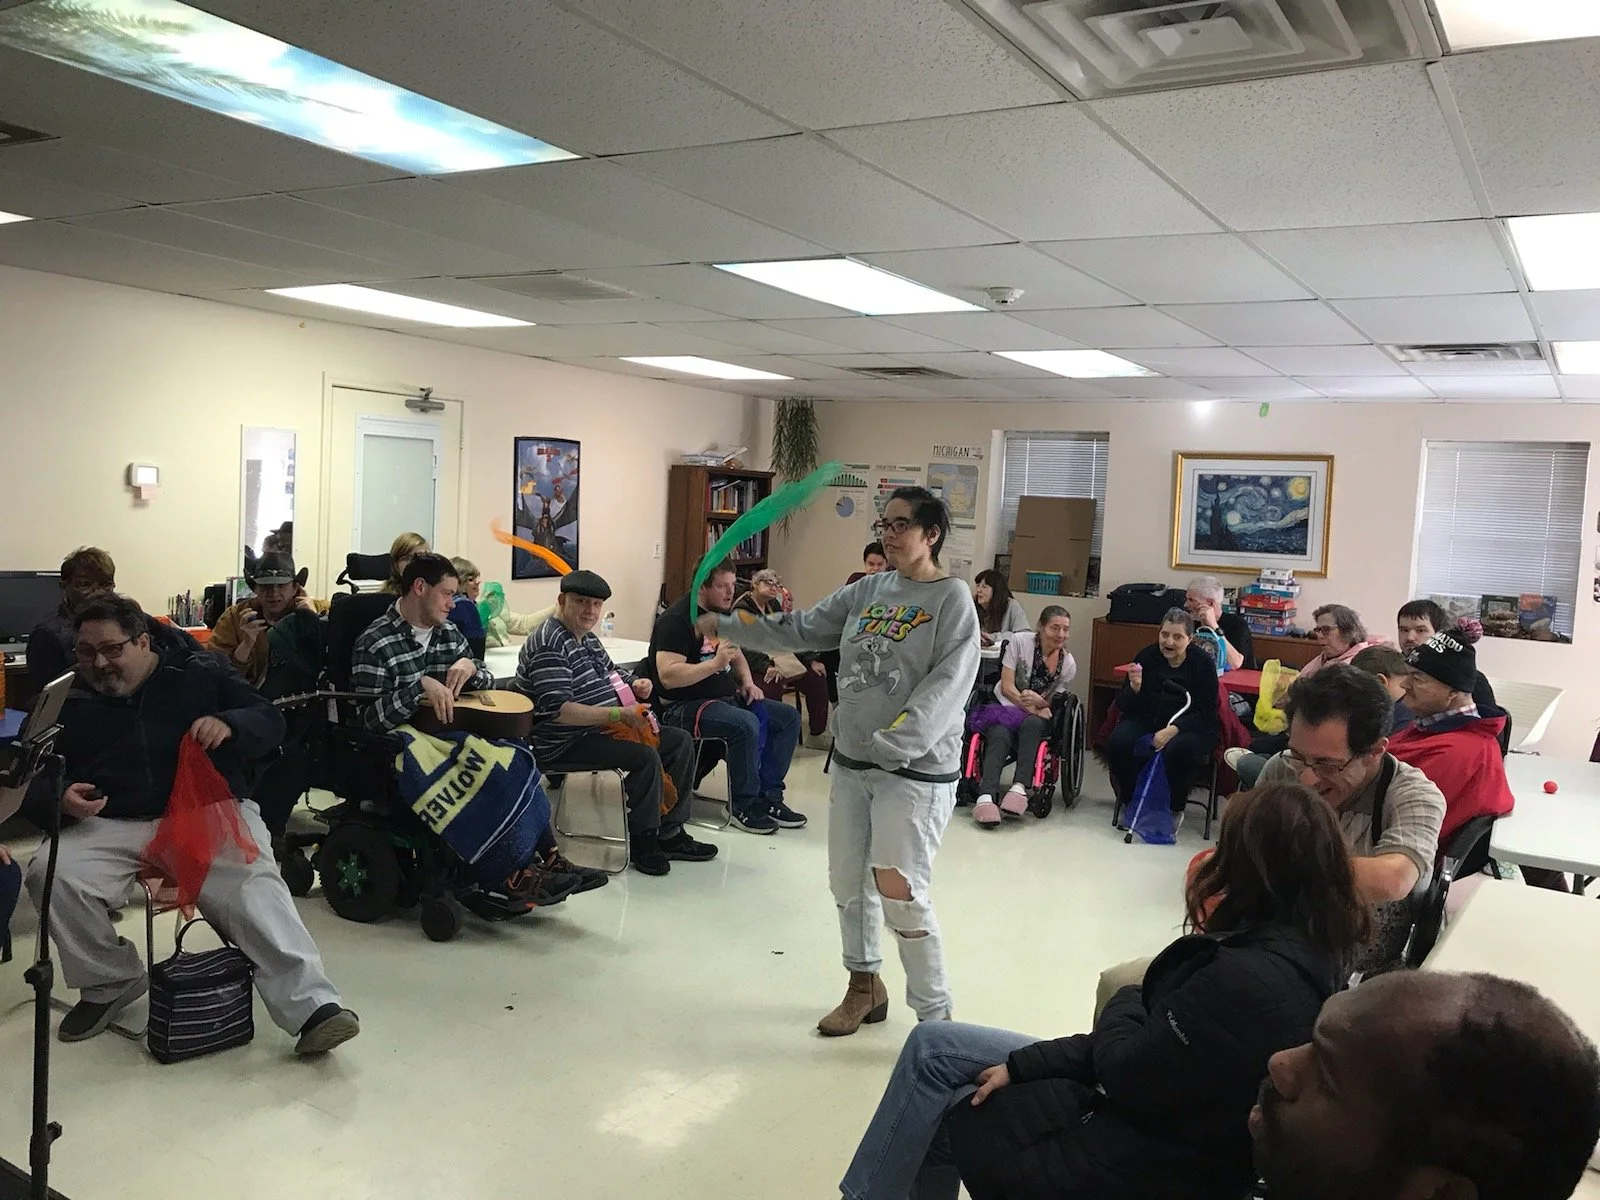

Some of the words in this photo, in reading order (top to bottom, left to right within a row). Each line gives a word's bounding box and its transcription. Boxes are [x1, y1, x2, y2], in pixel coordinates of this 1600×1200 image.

[933, 445, 970, 457] MICHIGAN
[860, 602, 933, 628] LOONEY
[856, 618, 912, 642] TUNES
